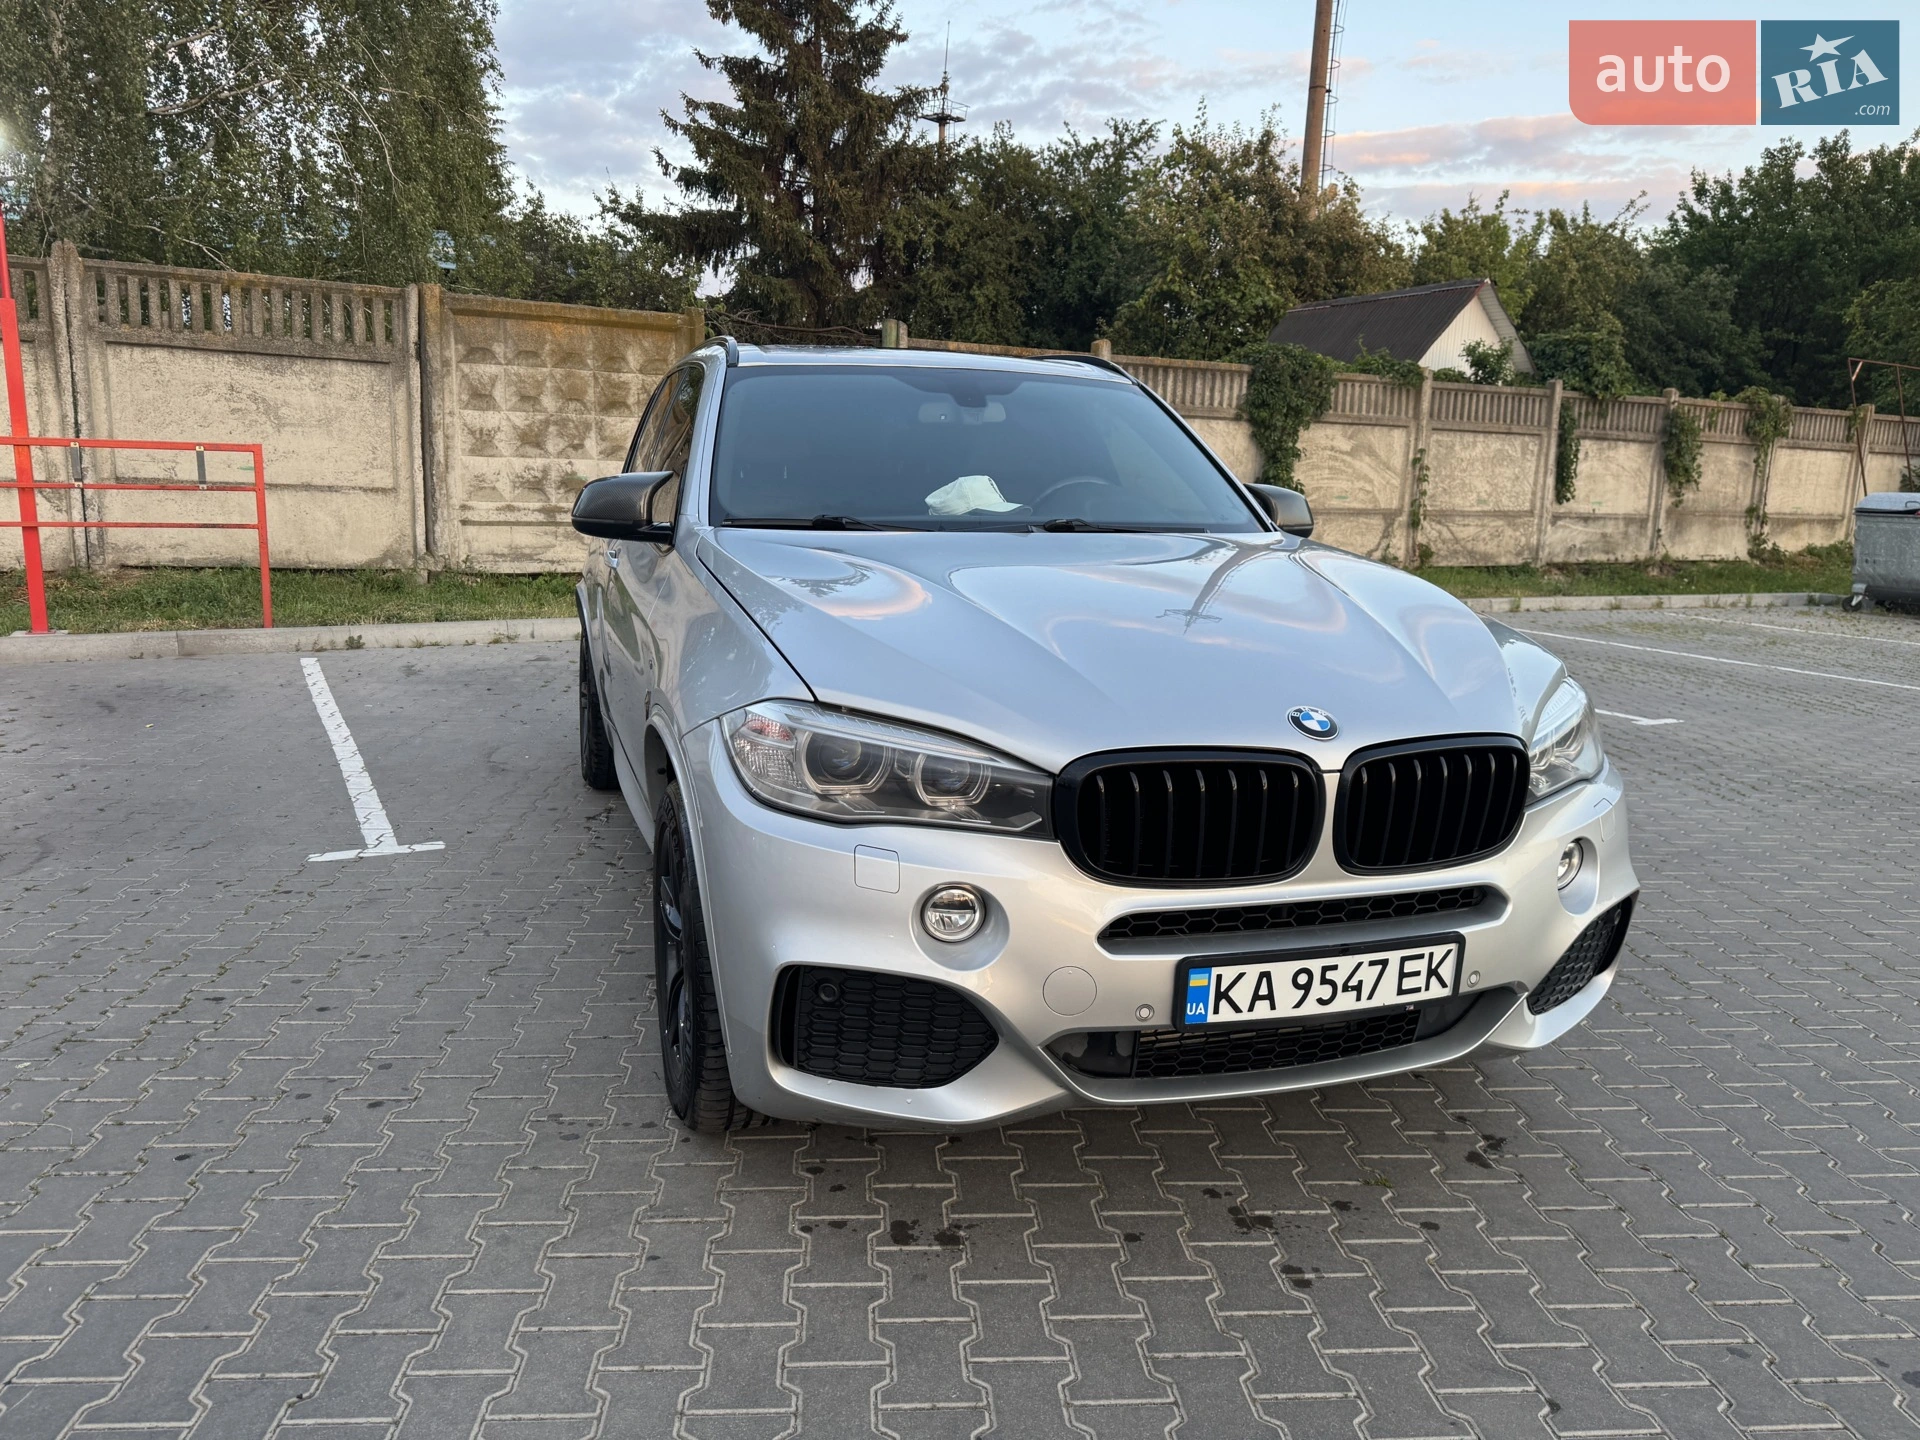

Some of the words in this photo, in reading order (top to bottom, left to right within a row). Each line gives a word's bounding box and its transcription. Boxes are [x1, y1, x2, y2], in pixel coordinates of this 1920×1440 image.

[1212, 970, 1277, 1015] KA
[1291, 958, 1390, 1010] 9547
[1396, 948, 1454, 996] EK
[1186, 1002, 1206, 1016] UA
